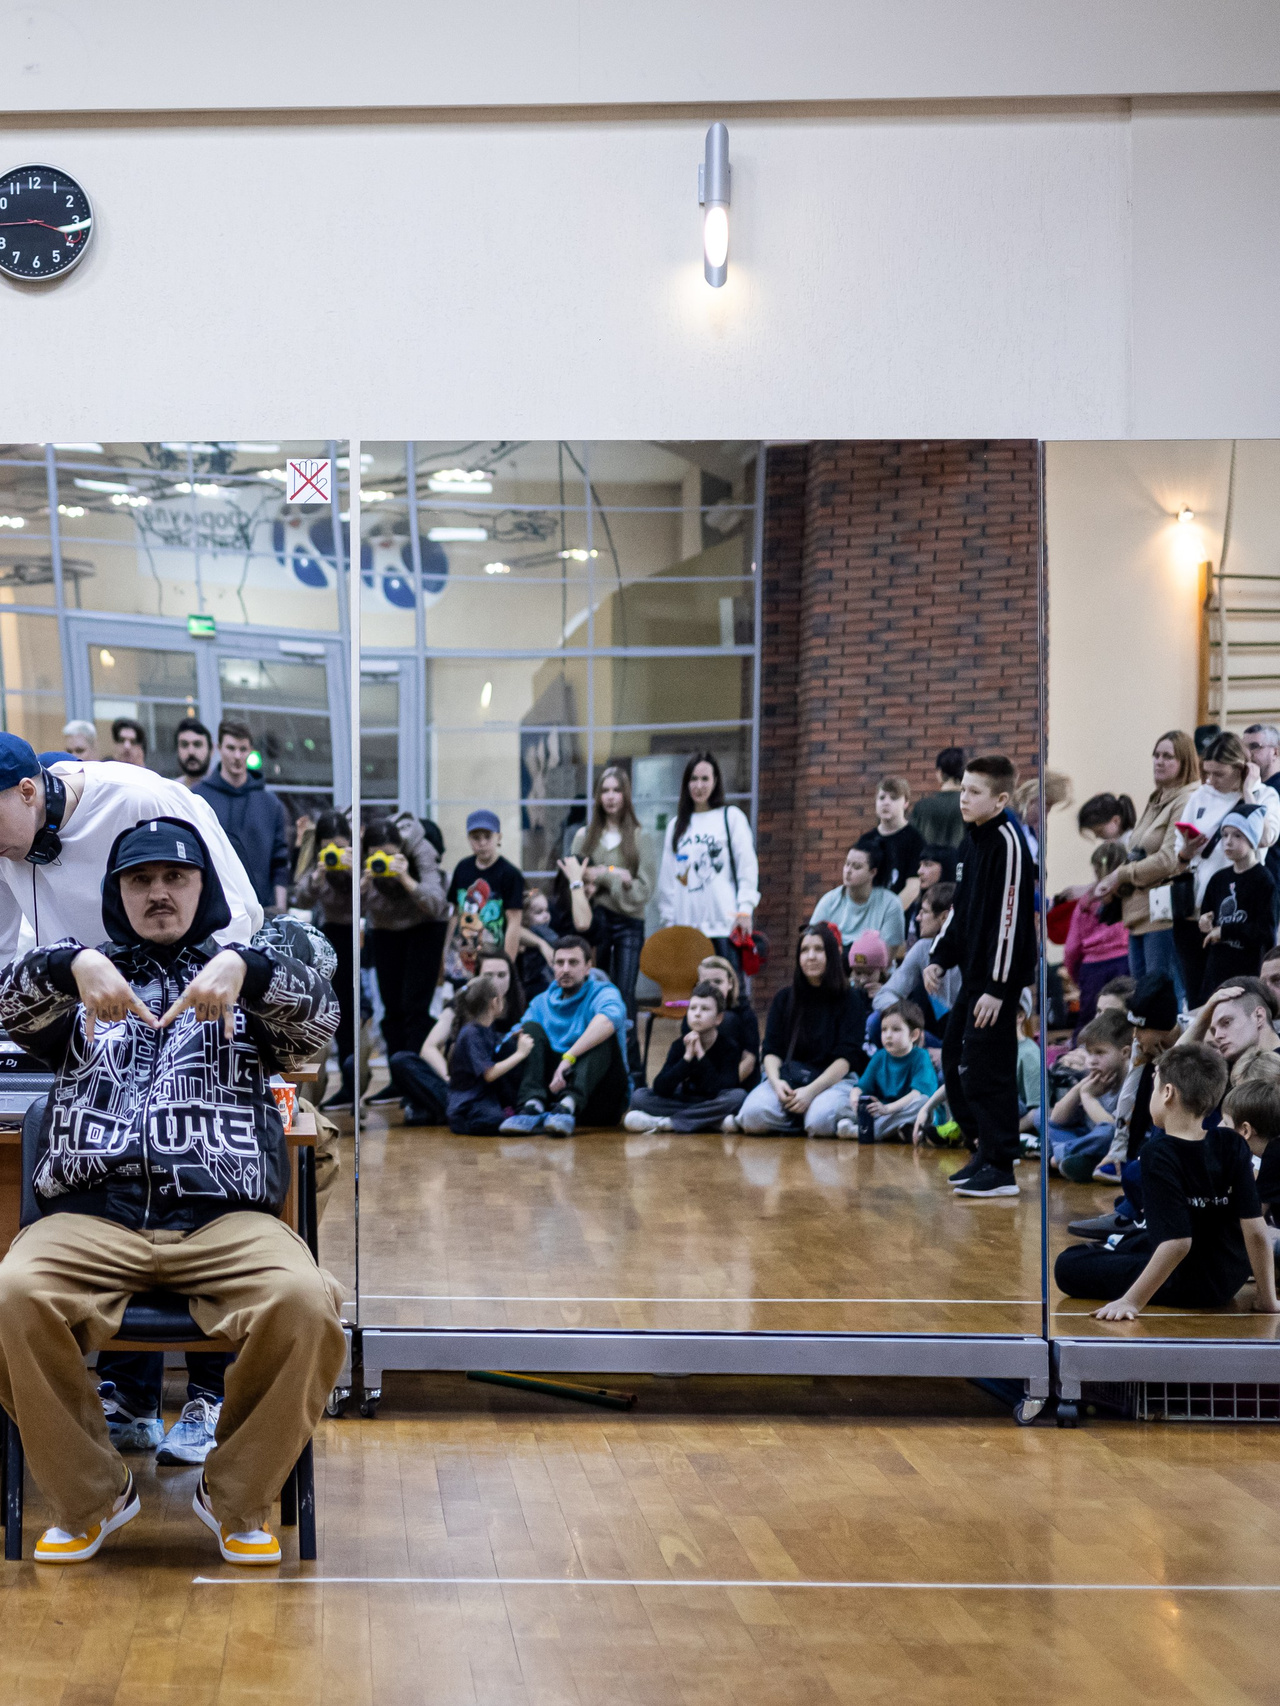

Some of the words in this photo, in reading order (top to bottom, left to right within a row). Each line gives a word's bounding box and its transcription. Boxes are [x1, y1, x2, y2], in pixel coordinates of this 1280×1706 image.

[10, 182, 20, 195] 11
[29, 177, 41, 189] 12
[53, 181, 57, 193] 1
[66, 195, 74, 207] 2
[72, 215, 79, 225] 3
[66, 235, 75, 248] 4
[12, 251, 20, 264] 7
[32, 256, 40, 268] 6
[52, 250, 60, 262] 5
